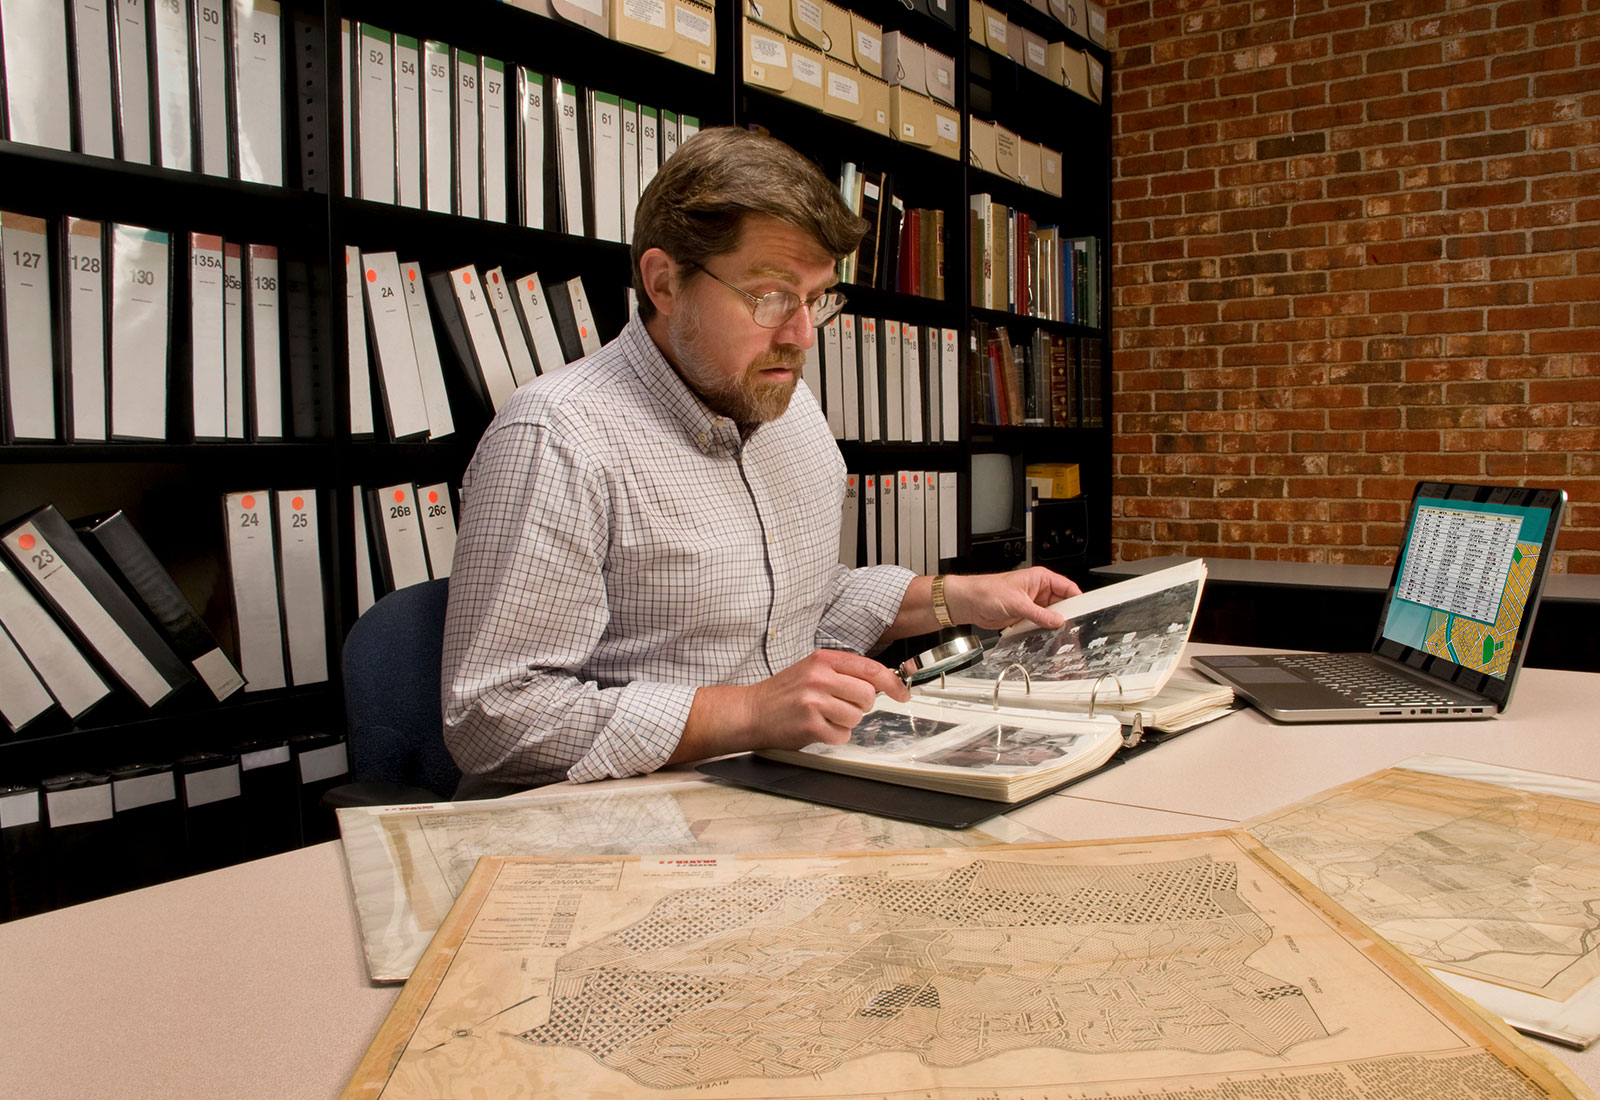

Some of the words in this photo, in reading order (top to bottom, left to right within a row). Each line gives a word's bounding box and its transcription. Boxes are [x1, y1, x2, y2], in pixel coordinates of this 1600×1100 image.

[202, 8, 219, 24] 50
[252, 32, 266, 46] 51
[369, 50, 384, 66] 52
[402, 61, 415, 76] 54
[430, 64, 446, 78] 55
[462, 74, 475, 89] 56
[488, 81, 502, 96] 57
[528, 94, 541, 108] 58
[563, 105, 575, 118] 59
[601, 113, 612, 126] 61
[625, 121, 635, 134] 62
[644, 126, 655, 139] 63
[667, 131, 676, 144] 64
[12, 250, 42, 270] 127
[71, 255, 101, 274] 128
[192, 254, 222, 270] 135A
[130, 268, 154, 286] 130
[224, 274, 242, 290] 35B
[254, 276, 276, 291] 136
[381, 286, 395, 298] 2A
[410, 282, 416, 294] 3
[496, 288, 504, 300] 5
[469, 290, 476, 302] 4
[531, 294, 538, 306] 6
[576, 299, 582, 310] 7
[828, 328, 836, 338] 13
[844, 332, 852, 340] 14
[890, 336, 896, 345] 17
[909, 341, 917, 350] 18
[946, 344, 954, 352] 20
[390, 505, 412, 519] 26B
[428, 504, 448, 518] 26C
[240, 513, 260, 528] 24
[291, 513, 308, 528] 25
[31, 548, 56, 570] 23
[696, 1080, 729, 1090] RIVER
